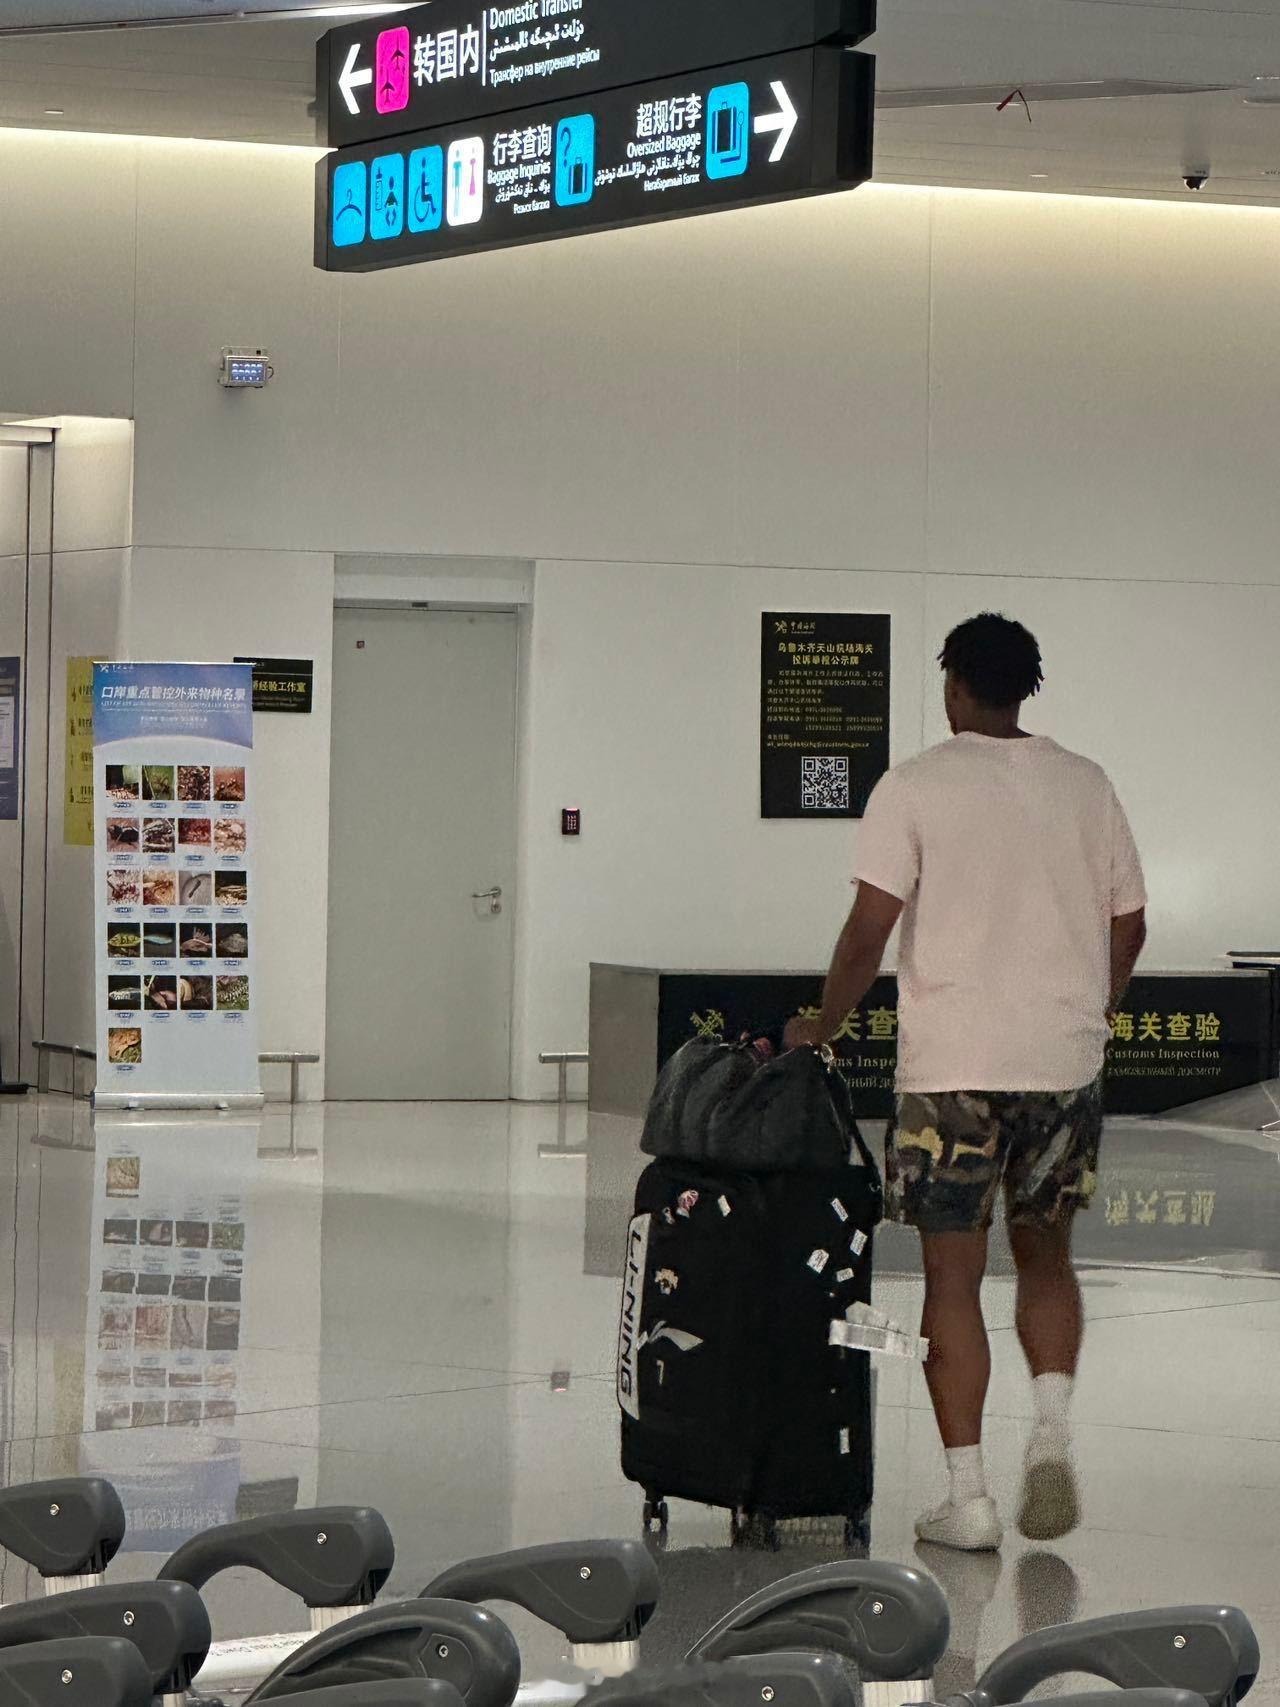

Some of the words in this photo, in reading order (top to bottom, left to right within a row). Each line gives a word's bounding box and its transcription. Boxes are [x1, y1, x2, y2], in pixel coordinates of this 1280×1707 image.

[489, 0, 539, 30] Domestic
[413, 24, 480, 87] 转国内
[489, 64, 524, 88] Трансфер
[524, 63, 534, 77] на
[576, 47, 600, 69] рейсы
[636, 92, 702, 138] 超规行李
[493, 123, 552, 166] 行李查询
[626, 135, 666, 158] Oversized
[666, 132, 702, 153] Baggage
[487, 167, 519, 187] Baggage
[519, 159, 551, 180] Inquiries
[1110, 1011, 1221, 1042] 海关查验
[1106, 1047, 1155, 1060] Customs
[1158, 1047, 1220, 1061] Inspection
[621, 1230, 642, 1397] LI-NING
